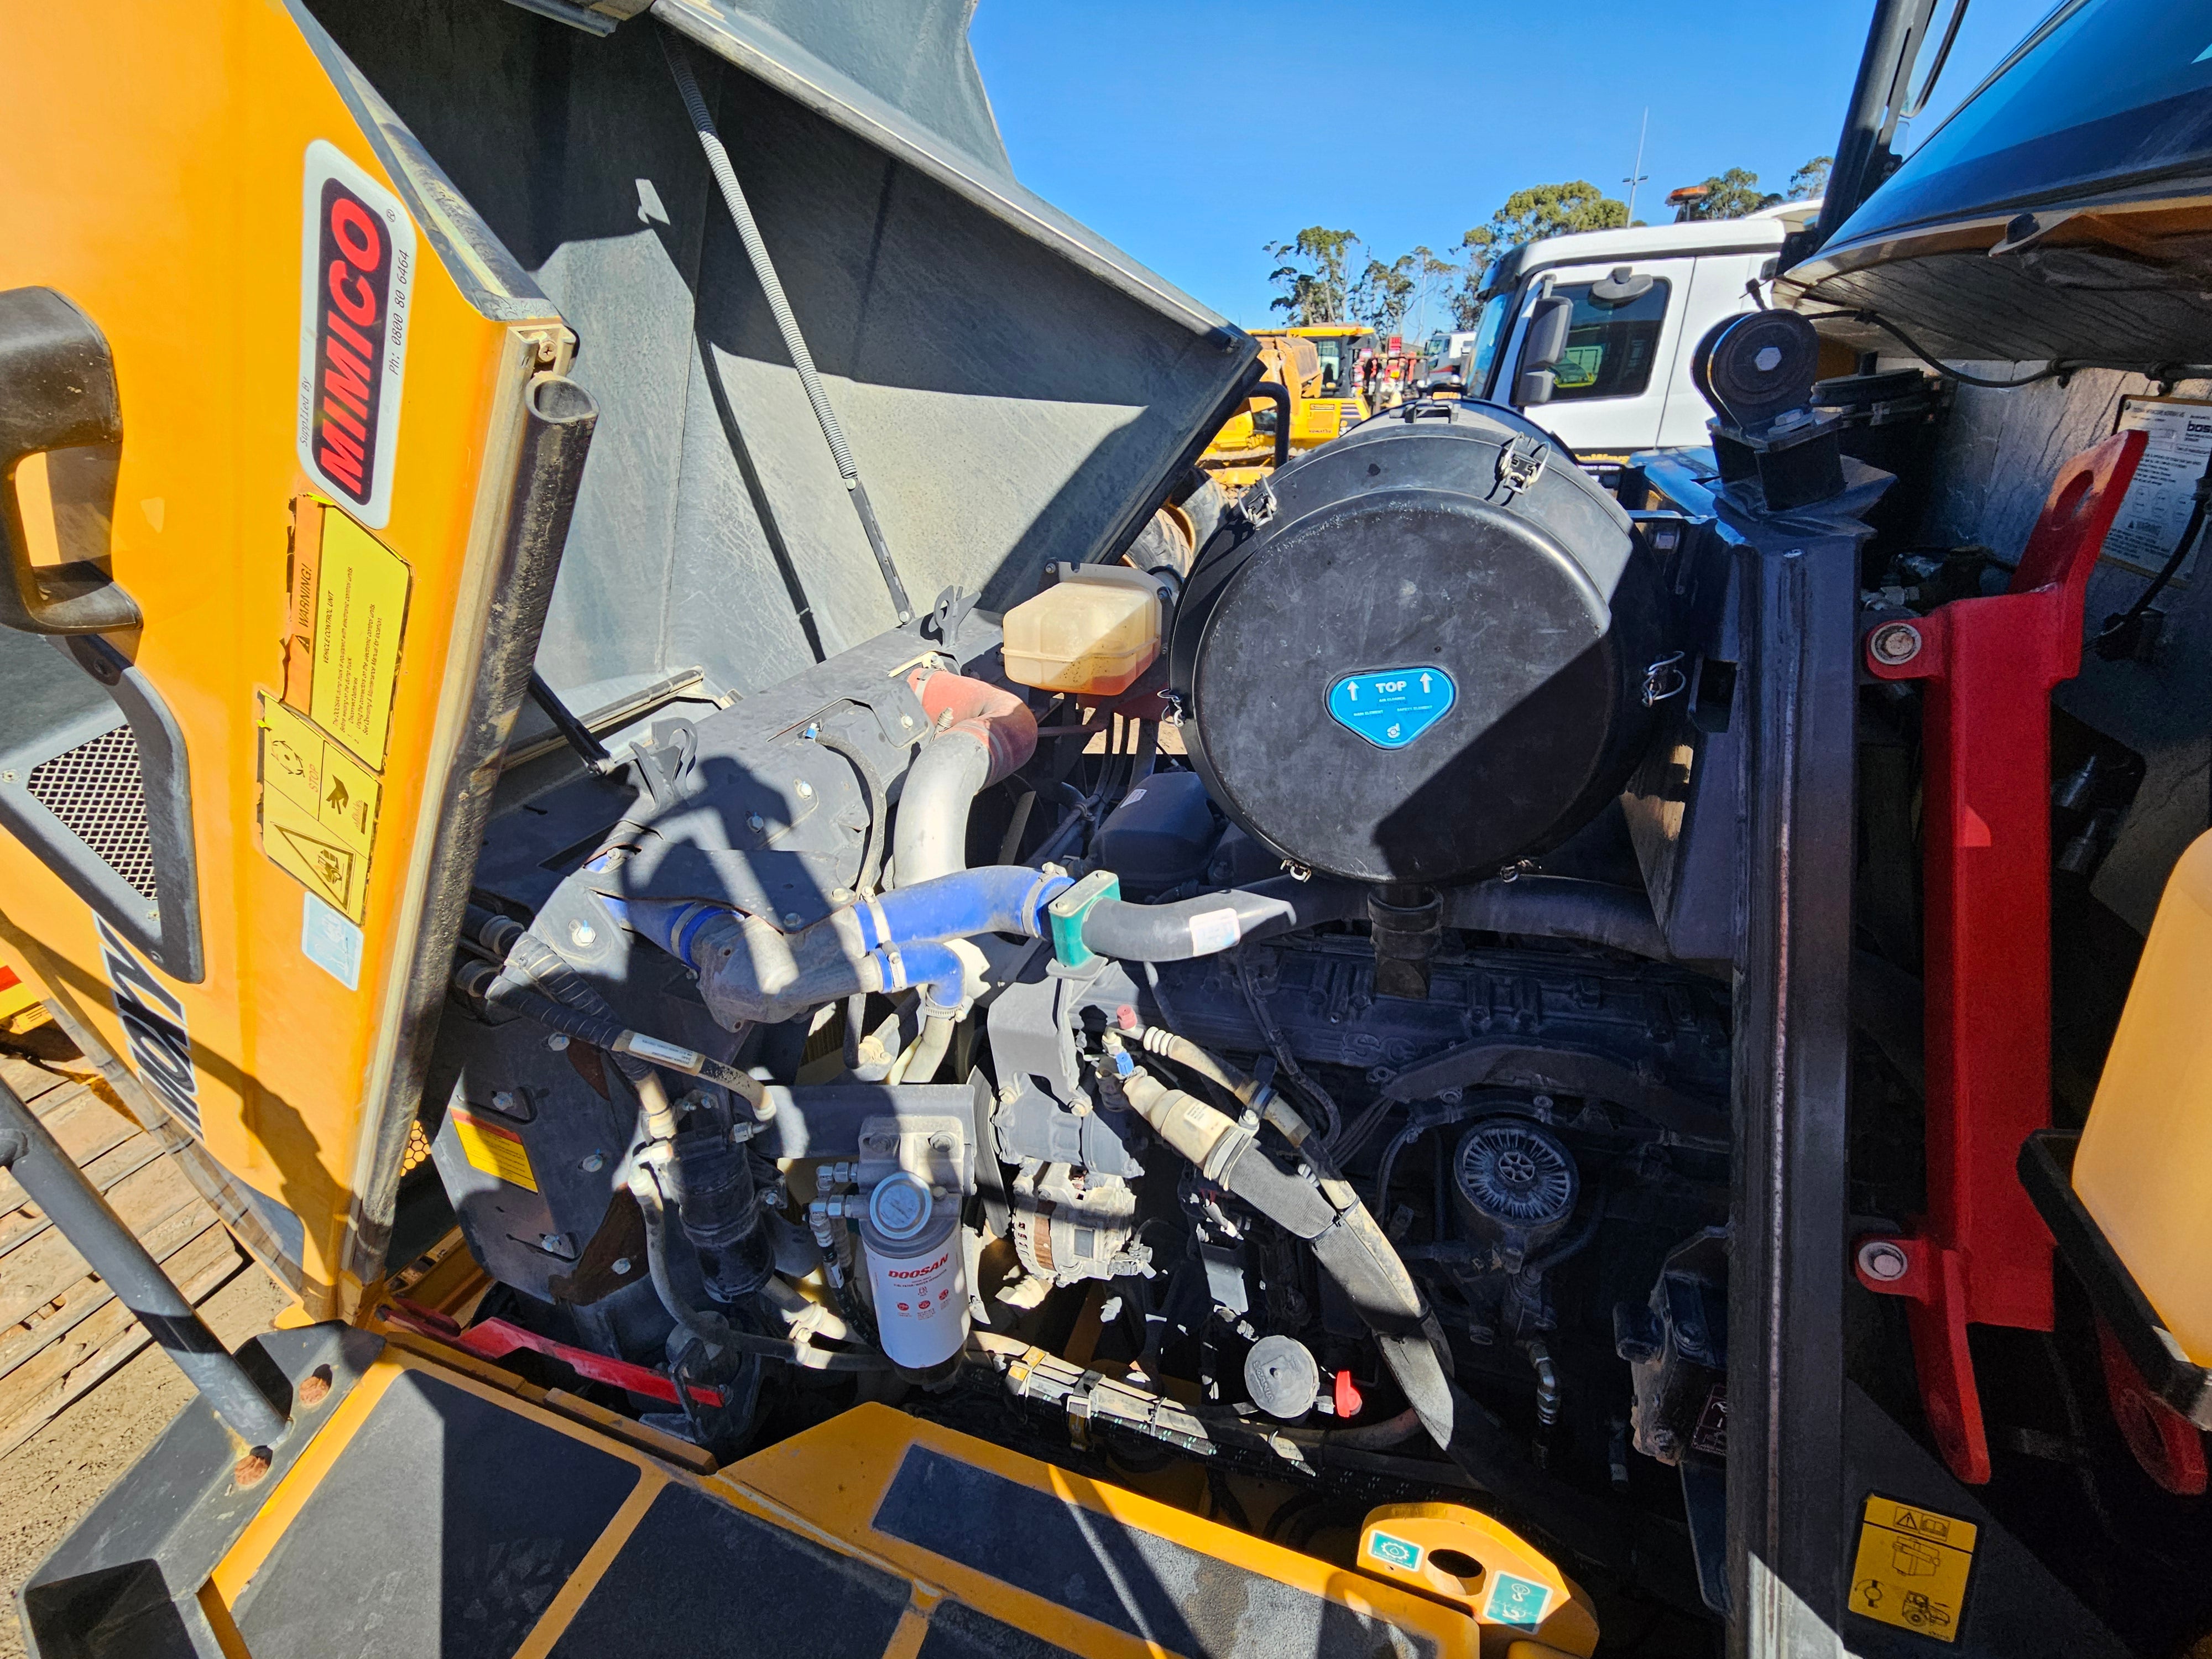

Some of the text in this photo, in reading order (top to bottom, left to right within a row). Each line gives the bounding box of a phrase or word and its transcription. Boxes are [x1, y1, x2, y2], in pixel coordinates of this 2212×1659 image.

[388, 249, 409, 375] Ph: 0800 80 6464
[319, 197, 382, 495] MIMICO
[299, 375, 313, 447] Supplied By
[2187, 420, 2212, 433] bos
[298, 563, 312, 628] WARNING!
[325, 608, 333, 638] CONTROL
[362, 670, 367, 679] on
[367, 666, 376, 698] Maintenance
[1375, 681, 1407, 693] TOP
[363, 702, 373, 726] Operating
[308, 764, 319, 793] STOP
[888, 1252, 949, 1279] DOOSAN
[1253, 1360, 1274, 1402] SCANIA
